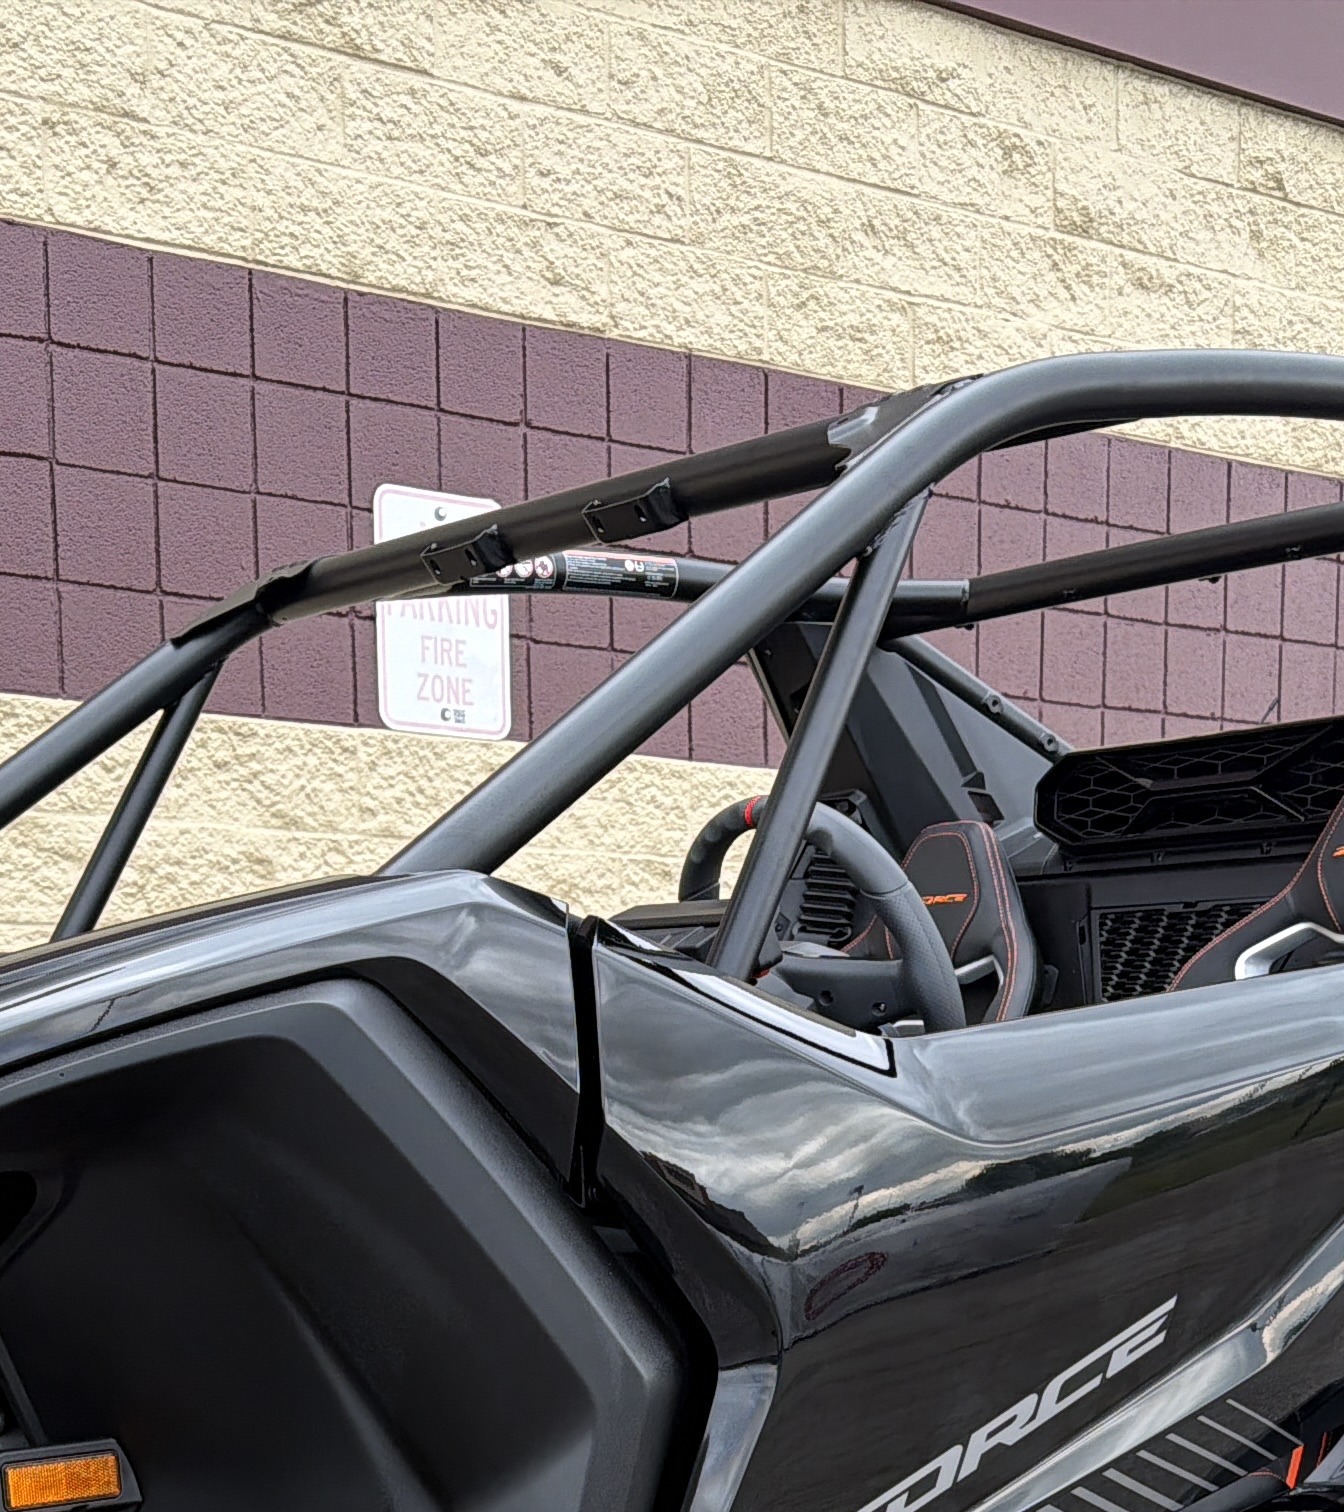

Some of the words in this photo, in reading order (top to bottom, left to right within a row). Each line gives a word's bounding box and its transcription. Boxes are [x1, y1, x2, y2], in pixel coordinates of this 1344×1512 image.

[420, 634, 468, 668] FIRE
[416, 672, 475, 706] ZONE
[921, 893, 969, 905] ORCE
